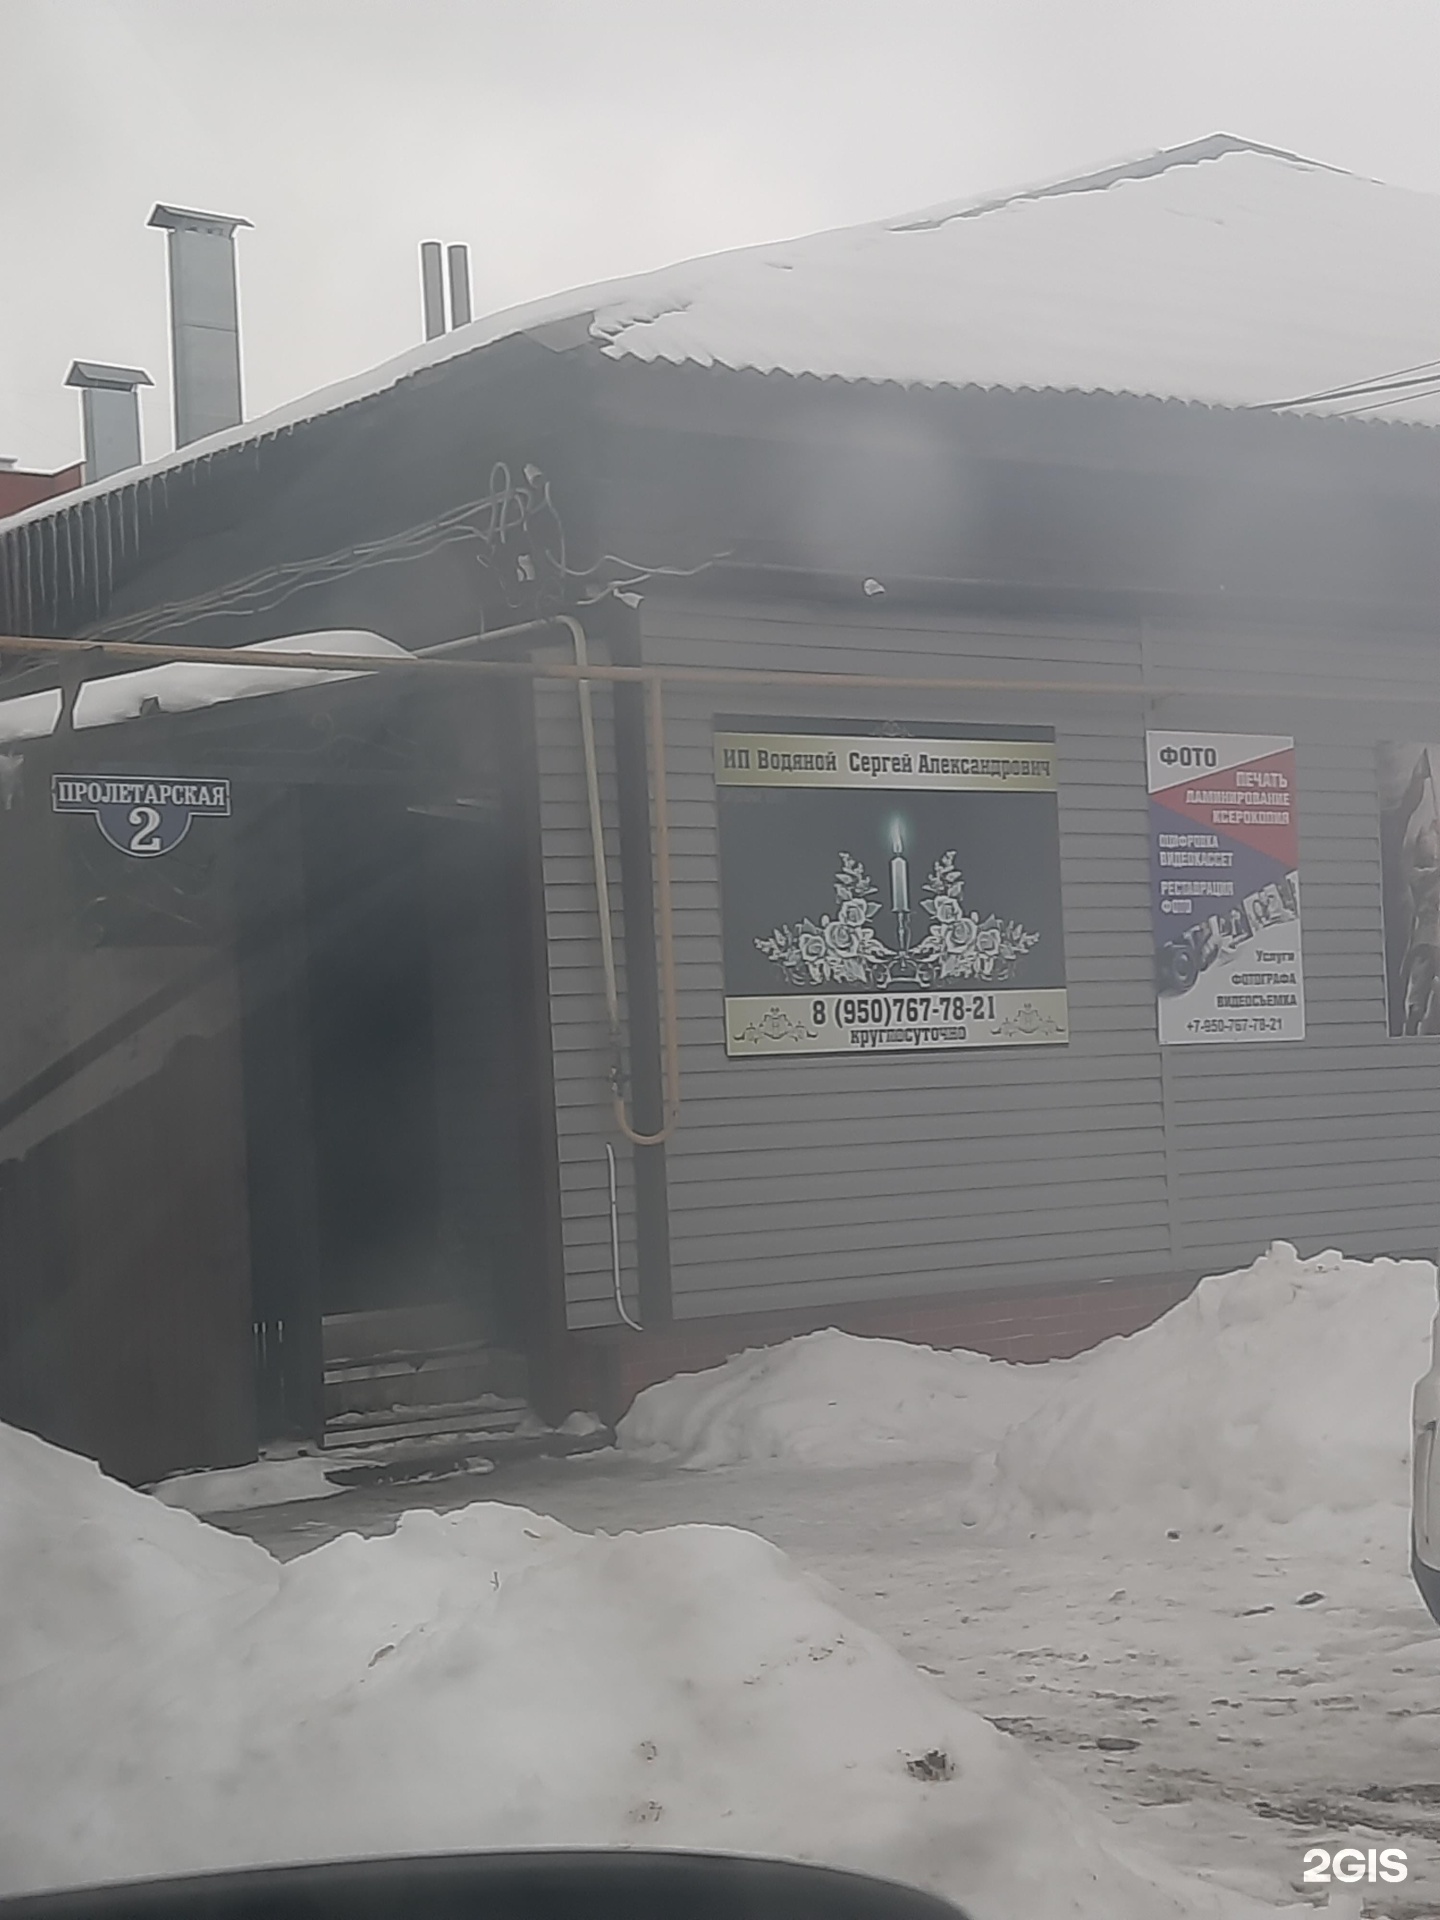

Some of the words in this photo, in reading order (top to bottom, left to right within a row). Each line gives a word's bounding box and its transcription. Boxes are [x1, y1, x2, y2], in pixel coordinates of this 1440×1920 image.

[723, 748, 750, 769] ИП
[757, 750, 837, 772] Водяной
[849, 752, 913, 777] Сергей
[918, 754, 1051, 780] Александрович
[1159, 746, 1217, 767] ФОТО
[1236, 771, 1288, 788] ПЕЧАТЬ
[58, 781, 225, 806] ПРОЛЕТАРСКАЯ
[129, 806, 161, 850] 2
[812, 1000, 826, 1025] 8
[835, 995, 995, 1028] (950)767-78-21
[850, 1027, 967, 1047] круглосуточно
[1187, 1018, 1282, 1033] +7-950-767-78-21
